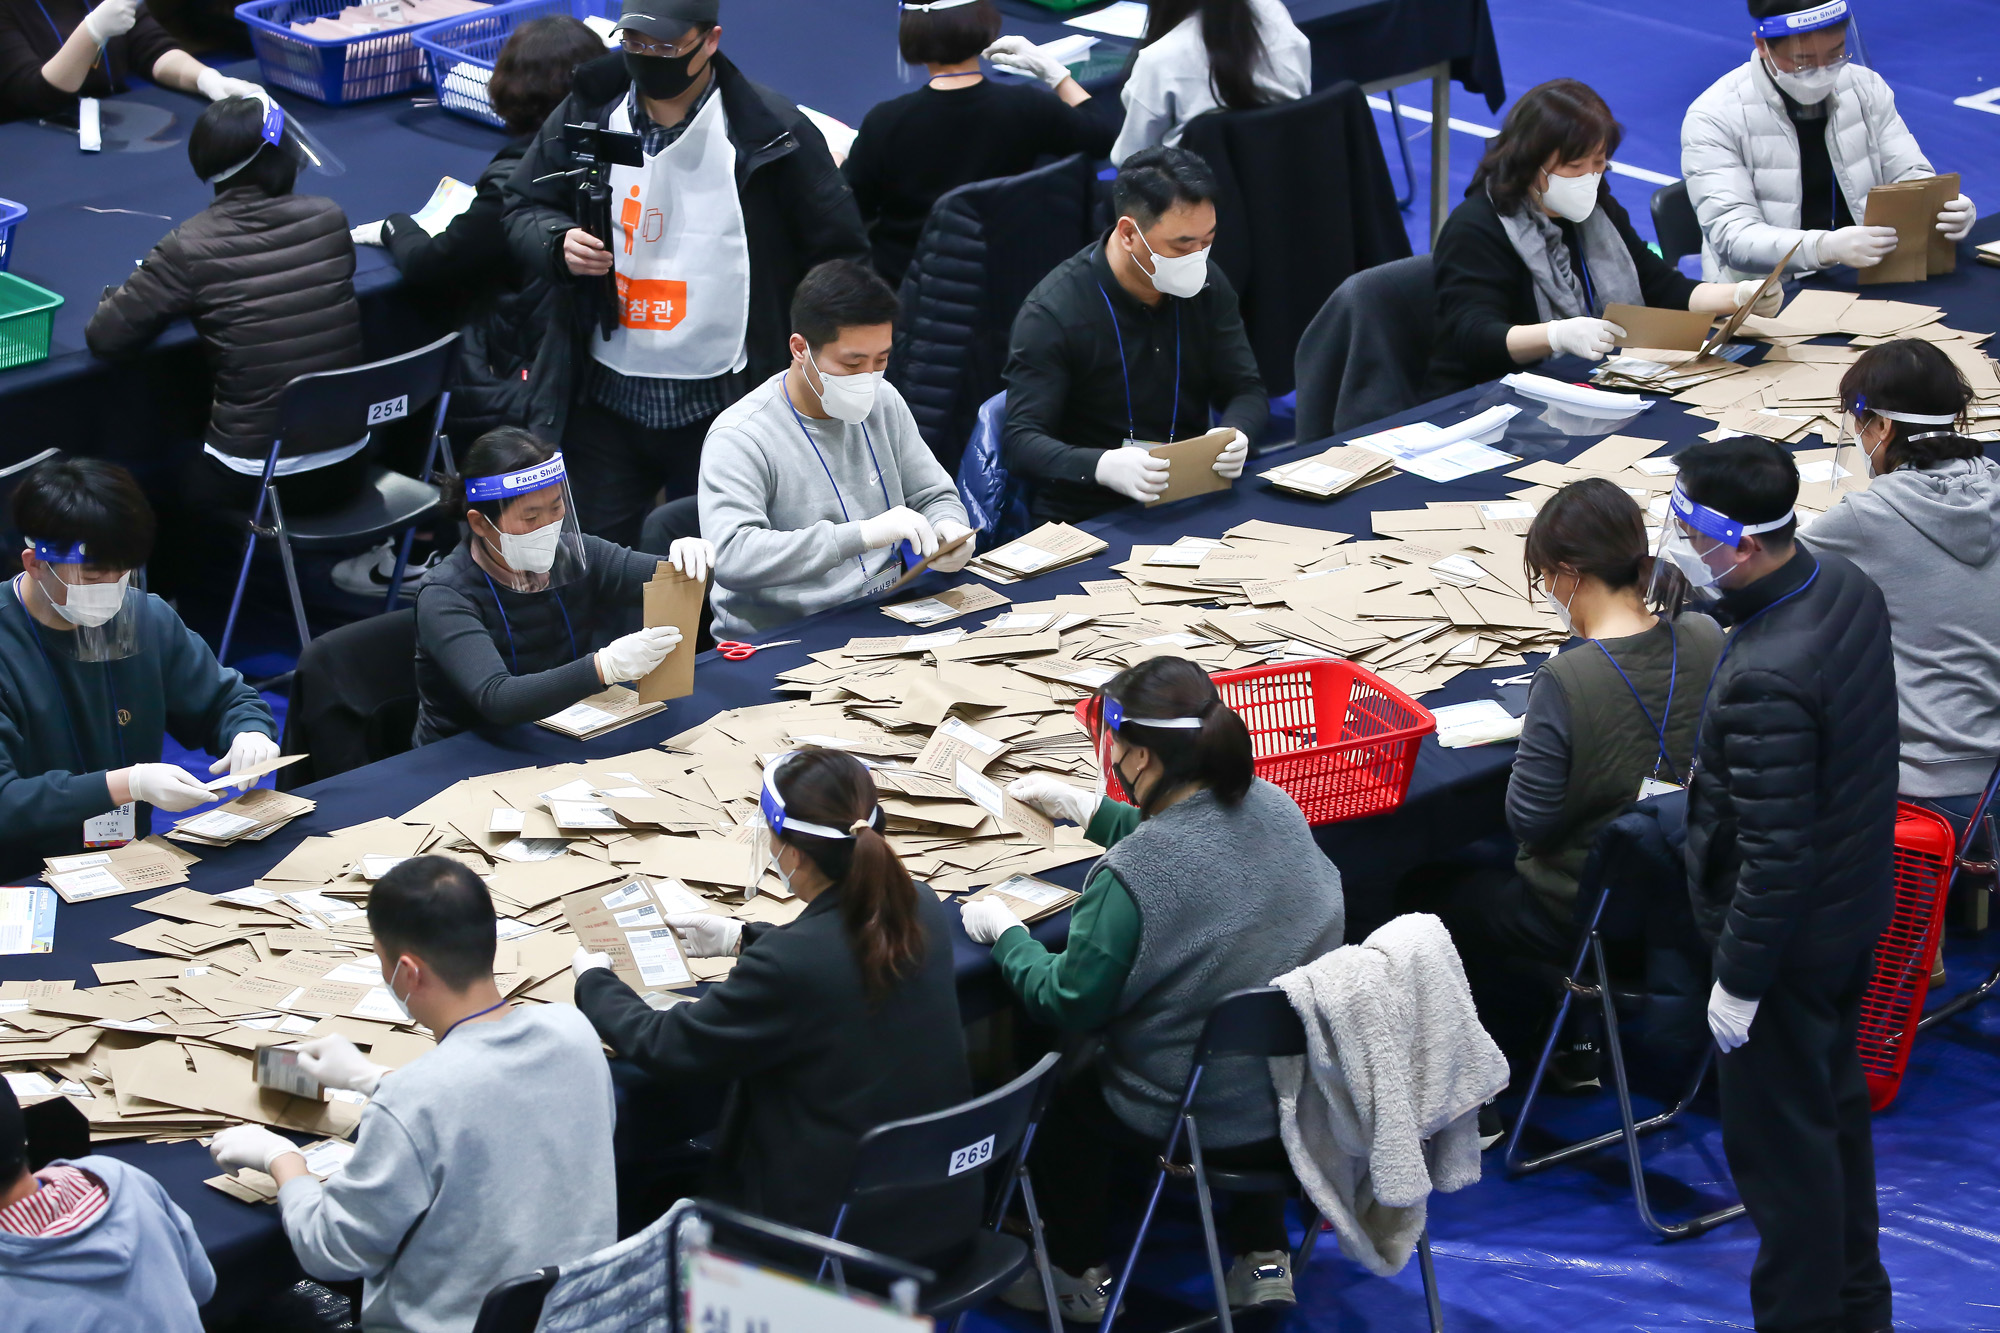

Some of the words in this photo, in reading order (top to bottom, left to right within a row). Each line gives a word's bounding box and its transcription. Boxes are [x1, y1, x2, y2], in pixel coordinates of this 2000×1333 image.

[1797, 15, 1818, 24] Face
[1820, 5, 1842, 19] Shield
[372, 398, 404, 420] 254
[515, 472, 538, 485] Face
[539, 464, 562, 478] Shield
[1573, 1042, 1592, 1051] NIKE
[955, 1141, 990, 1170] 269
